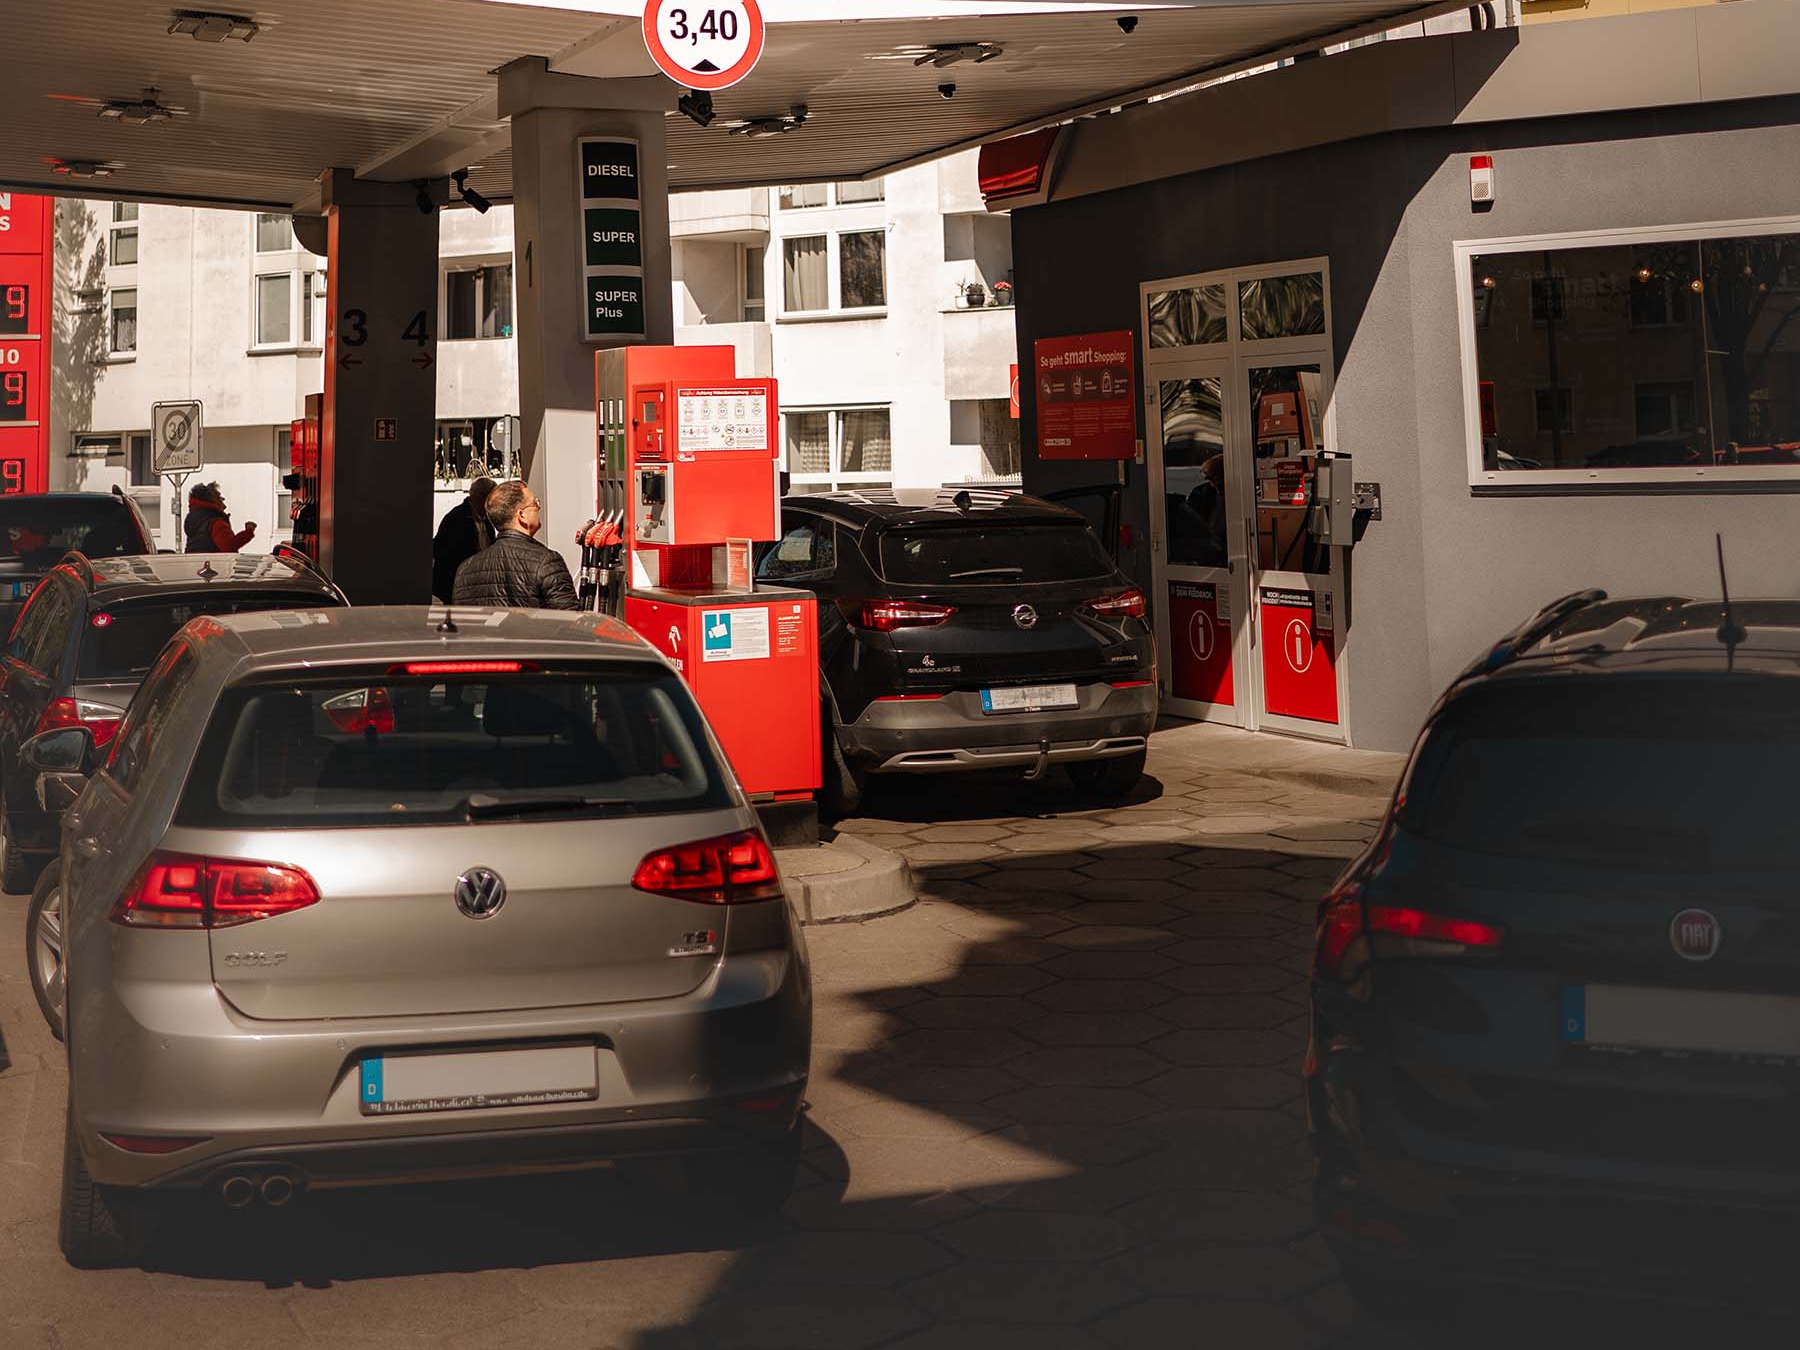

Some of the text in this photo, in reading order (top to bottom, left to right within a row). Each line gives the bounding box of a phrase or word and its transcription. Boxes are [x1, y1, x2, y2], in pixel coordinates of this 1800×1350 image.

[669, 8, 738, 46] 3,40
[587, 164, 635, 178] DIESEL
[592, 231, 635, 243] SUPER
[595, 291, 638, 303] SUPER
[596, 307, 623, 318] Plus
[341, 309, 429, 347] 3 4
[1064, 347, 1093, 365] smart
[168, 421, 186, 440] 30
[166, 453, 189, 466] ZONE
[1680, 923, 1713, 947] FIAT
[224, 952, 288, 968] GOLF
